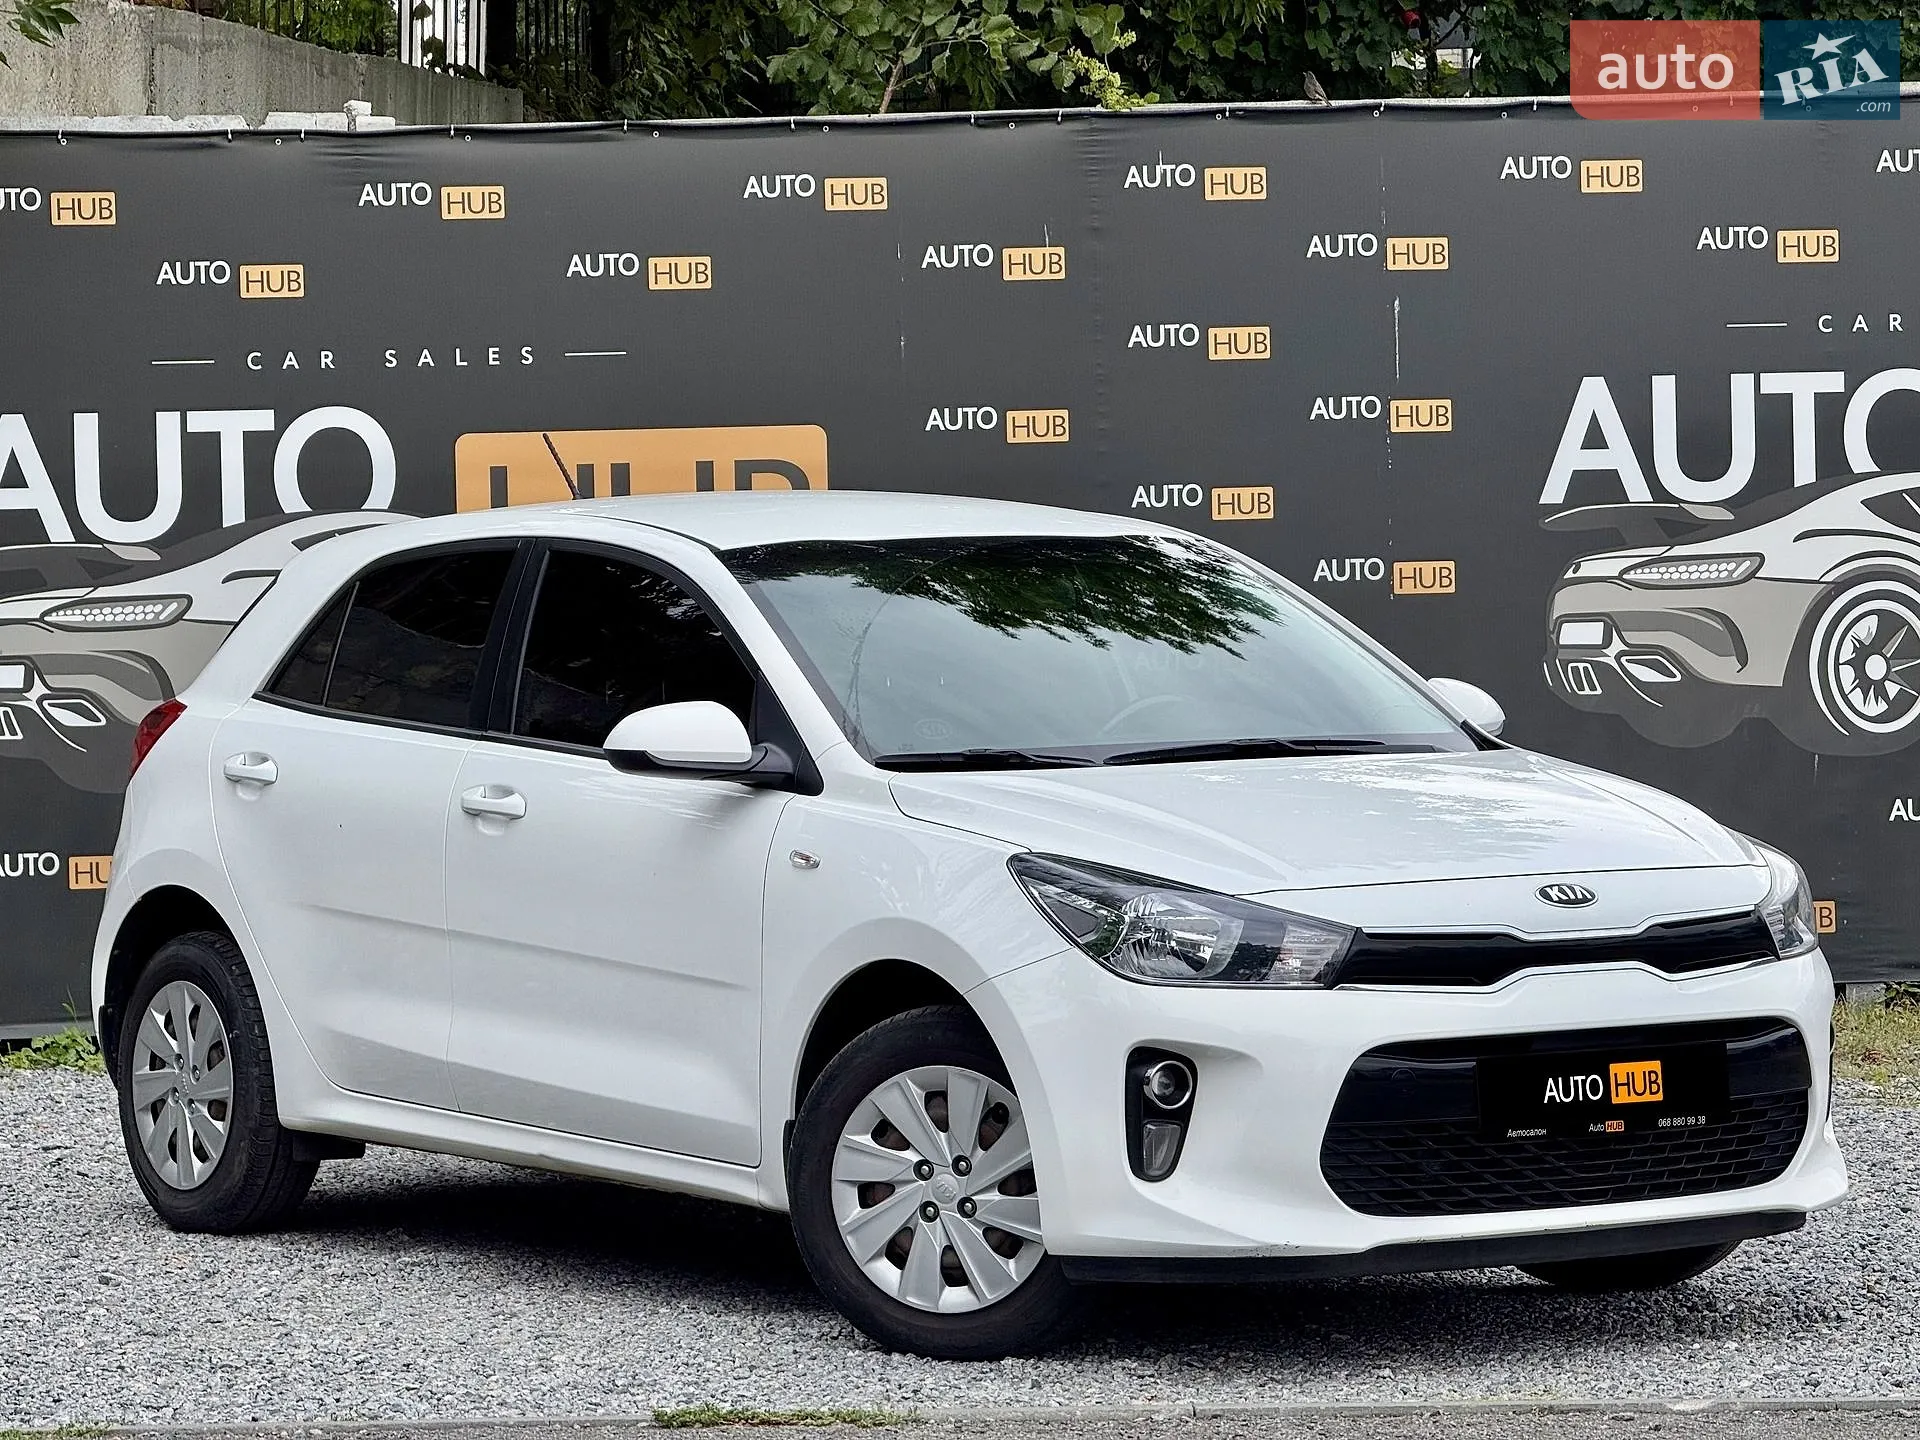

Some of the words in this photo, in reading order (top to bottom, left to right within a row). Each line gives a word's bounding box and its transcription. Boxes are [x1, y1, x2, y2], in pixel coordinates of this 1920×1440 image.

[1124, 164, 1195, 188] AUTO
[1210, 173, 1264, 196] HUB
[1500, 156, 1572, 180] AUTO
[1585, 165, 1640, 188] HUB
[0, 187, 41, 211] TO
[56, 198, 113, 220] HUB
[359, 182, 431, 206] AUTO
[447, 191, 502, 215] HUB
[744, 174, 815, 198] AUTO
[830, 184, 885, 206] HUB
[1307, 234, 1377, 258] AUTO
[1392, 244, 1446, 266] HUB
[1697, 226, 1768, 250] AUTO
[1783, 236, 1836, 258] HUB
[567, 253, 639, 278] AUTO
[654, 263, 709, 285] HUB
[922, 244, 993, 269] AUTO
[1008, 253, 1062, 276] HUB
[156, 261, 230, 286] AUTO
[245, 271, 301, 293] HUB
[1128, 324, 1199, 348] AUTO
[1213, 332, 1267, 355] HUB
[1818, 314, 1903, 333] CAR
[247, 350, 336, 370] CAR
[385, 346, 534, 367] SALES
[925, 407, 997, 431] AUTO
[1012, 416, 1067, 439] HUB
[1310, 396, 1381, 420] AUTO
[1395, 405, 1449, 428] HUB
[1132, 484, 1202, 508] AUTO
[1217, 492, 1271, 516] HUB
[1314, 558, 1384, 582] AUTO
[1399, 566, 1453, 590] HUB
[0, 852, 60, 877] UTO
[1542, 885, 1594, 902] KIA
[1544, 1074, 1604, 1103] AUTO
[1614, 1070, 1661, 1098] HUB
[1507, 1127, 1547, 1138] Автосалон
[1589, 1122, 1605, 1132] Auto
[1606, 1121, 1623, 1131] HUB
[1658, 1118, 1671, 1127] 068
[1672, 1117, 1685, 1126] 880
[1687, 1116, 1696, 1125] 99
[1697, 1115, 1706, 1124] 38
